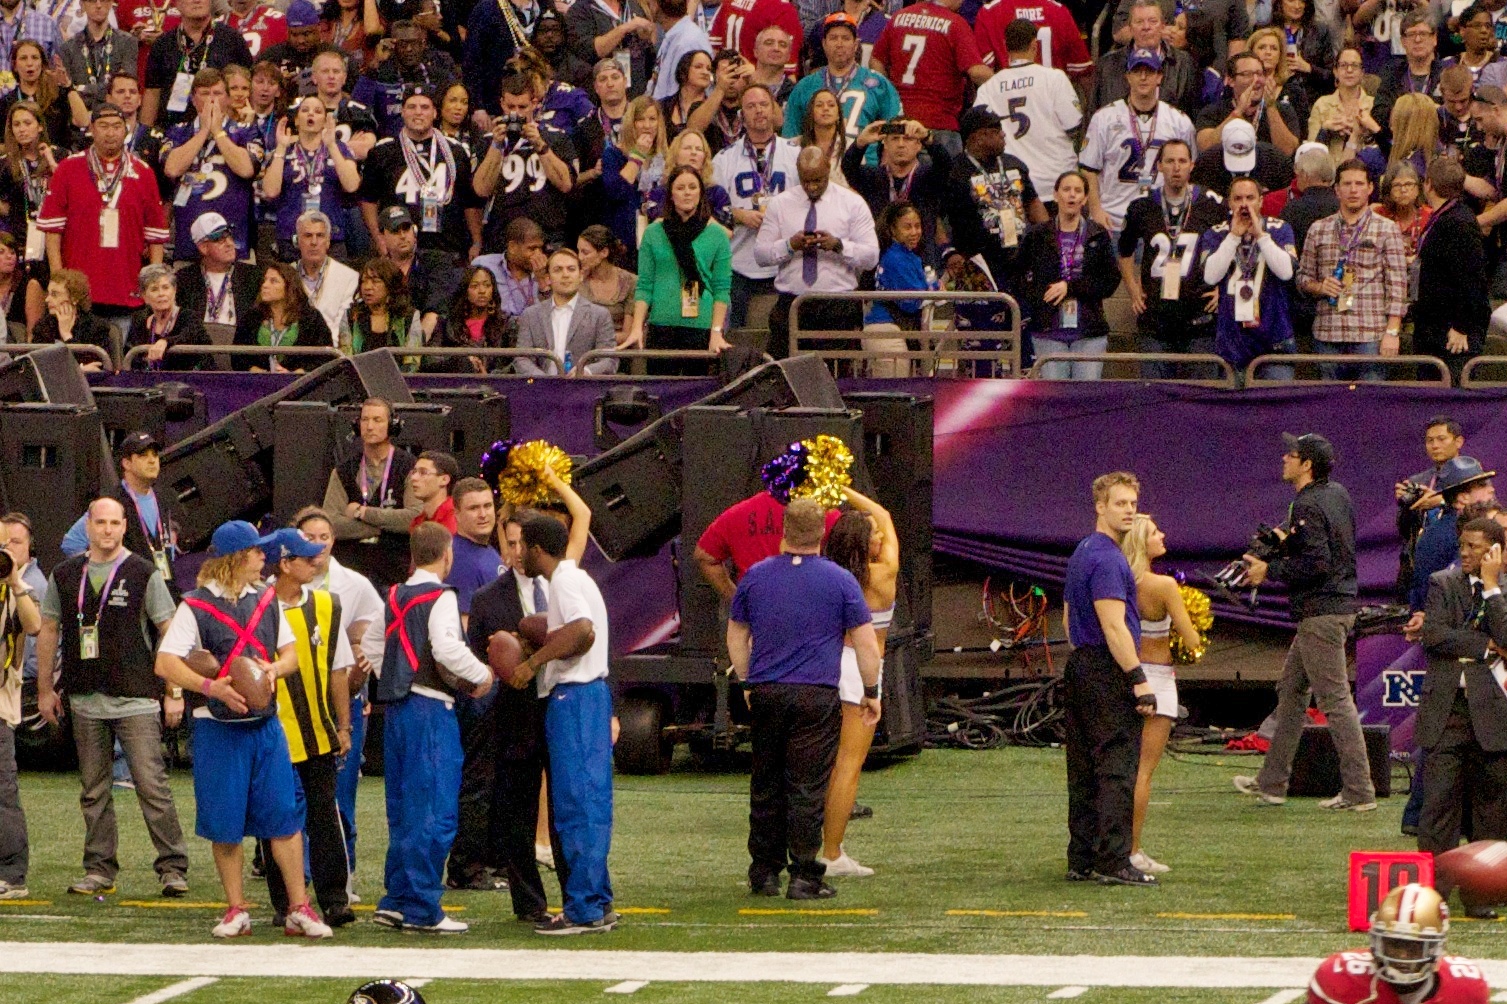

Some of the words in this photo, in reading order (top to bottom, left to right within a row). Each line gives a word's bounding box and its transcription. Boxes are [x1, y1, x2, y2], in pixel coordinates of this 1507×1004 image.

[893, 12, 951, 34] KAEPERNICK
[1014, 6, 1045, 22] GORE
[901, 34, 927, 85] 7
[1000, 76, 1034, 93] FLACCO
[1008, 96, 1031, 140] 5
[502, 153, 547, 193] 99
[1150, 232, 1199, 279] 27
